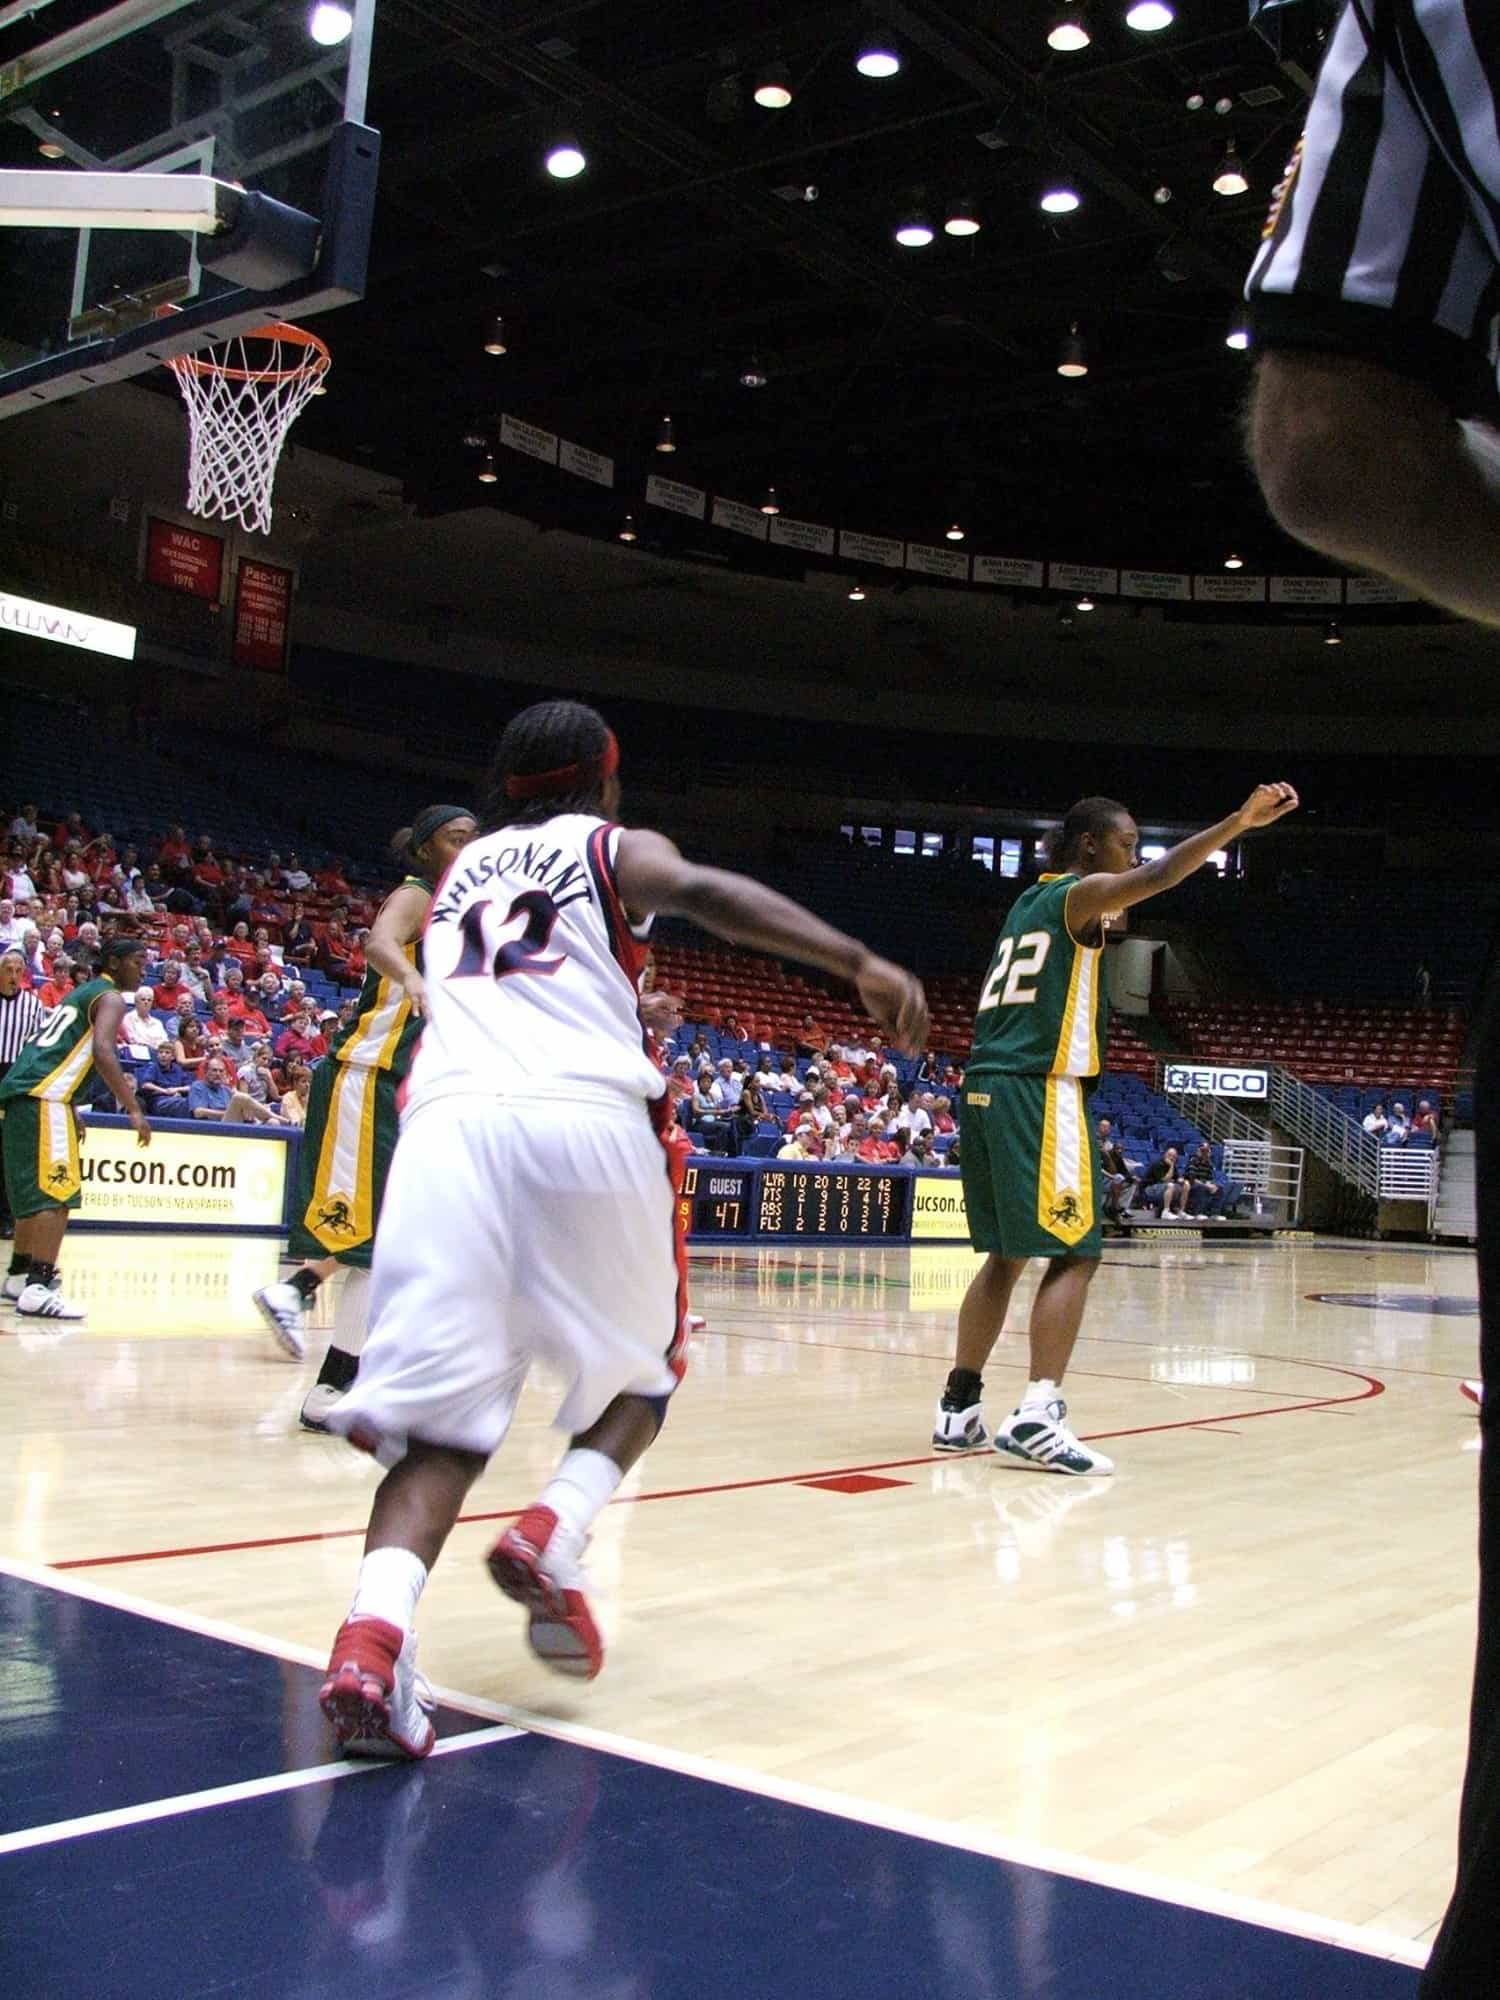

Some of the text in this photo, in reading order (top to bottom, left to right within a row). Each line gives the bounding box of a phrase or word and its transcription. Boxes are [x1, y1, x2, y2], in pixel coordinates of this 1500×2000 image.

[171, 532, 200, 551] WAC
[431, 842, 594, 925] WHISONANT
[444, 889, 569, 983] 12
[978, 931, 1051, 1012] 22
[1167, 1069, 1265, 1093] GEICO
[709, 1178, 743, 1195] GUEST
[763, 1173, 892, 1192] LYR 10 20 21 22 42
[797, 1189, 806, 1202] 2
[820, 1190, 828, 1203] 9
[842, 1190, 849, 1204] 3
[862, 1191, 870, 1204] 4
[877, 1191, 891, 1205] 13
[716, 1202, 739, 1228] 47
[760, 1202, 782, 1216] RBS
[819, 1204, 827, 1217] 3
[841, 1205, 849, 1218] 0
[861, 1205, 869, 1218] 3
[882, 1206, 890, 1219] 3
[760, 1217, 781, 1231] FLS
[796, 1218, 805, 1231] 2
[818, 1218, 826, 1231] 2
[840, 1219, 848, 1232] 0
[861, 1219, 869, 1232] 2
